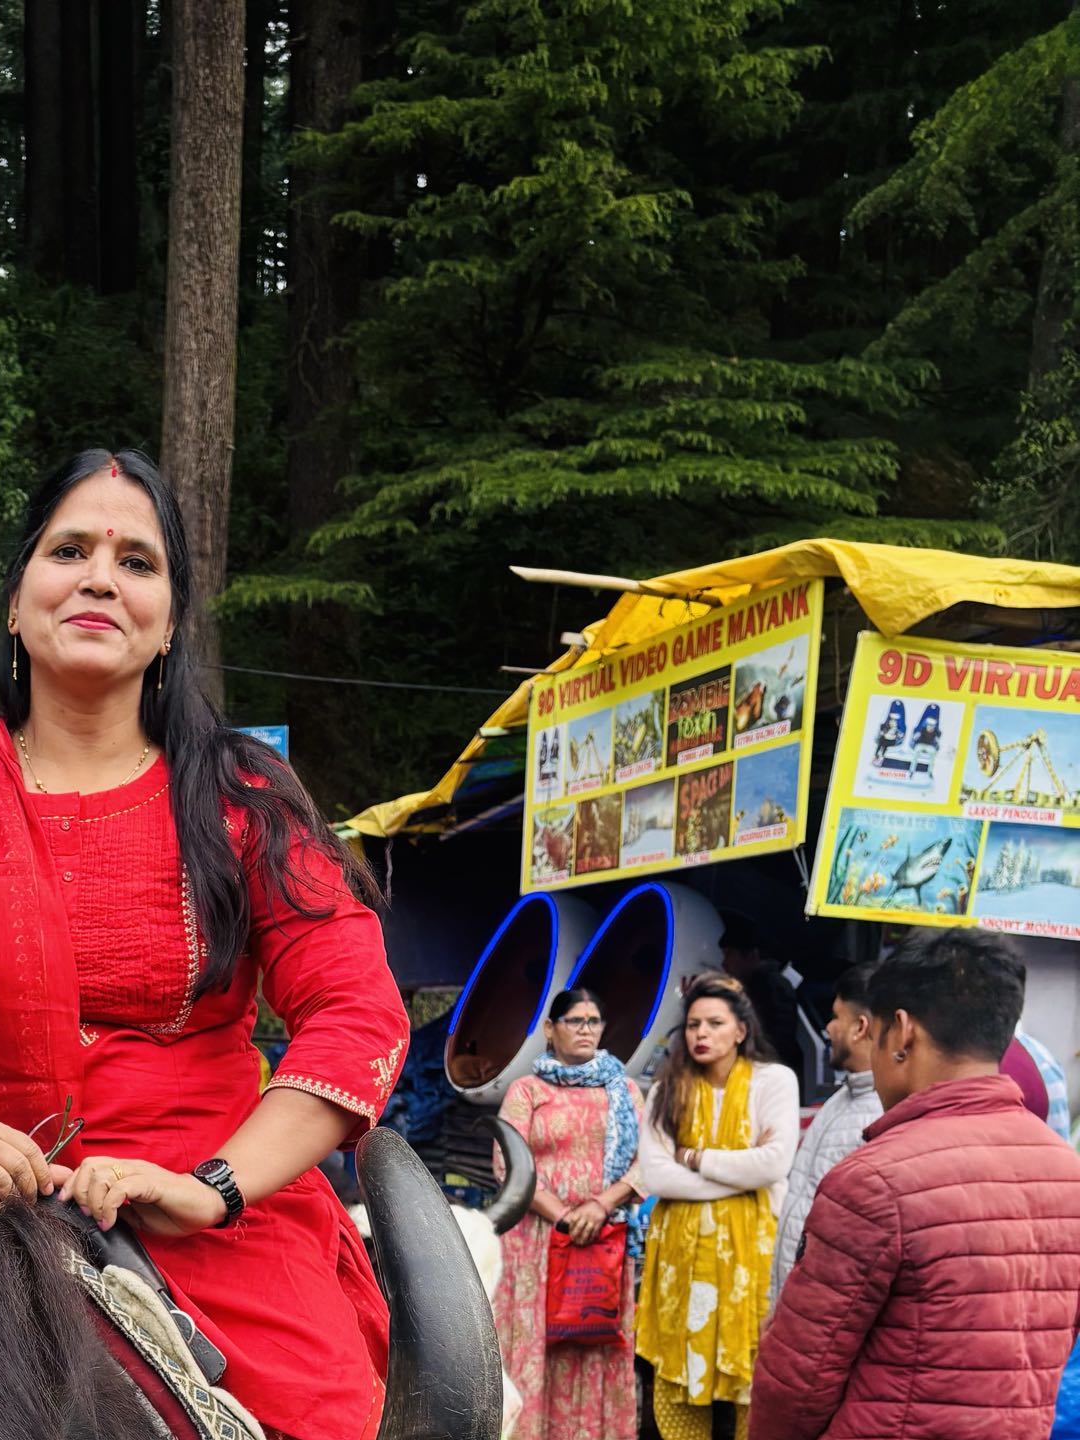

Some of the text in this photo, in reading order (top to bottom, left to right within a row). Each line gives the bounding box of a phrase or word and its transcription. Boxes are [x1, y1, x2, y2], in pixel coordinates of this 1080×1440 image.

[538, 581, 811, 717] 9D VIRTUAL VIDEO GAME MAYANK
[877, 649, 1080, 702] 9D VIRTUA
